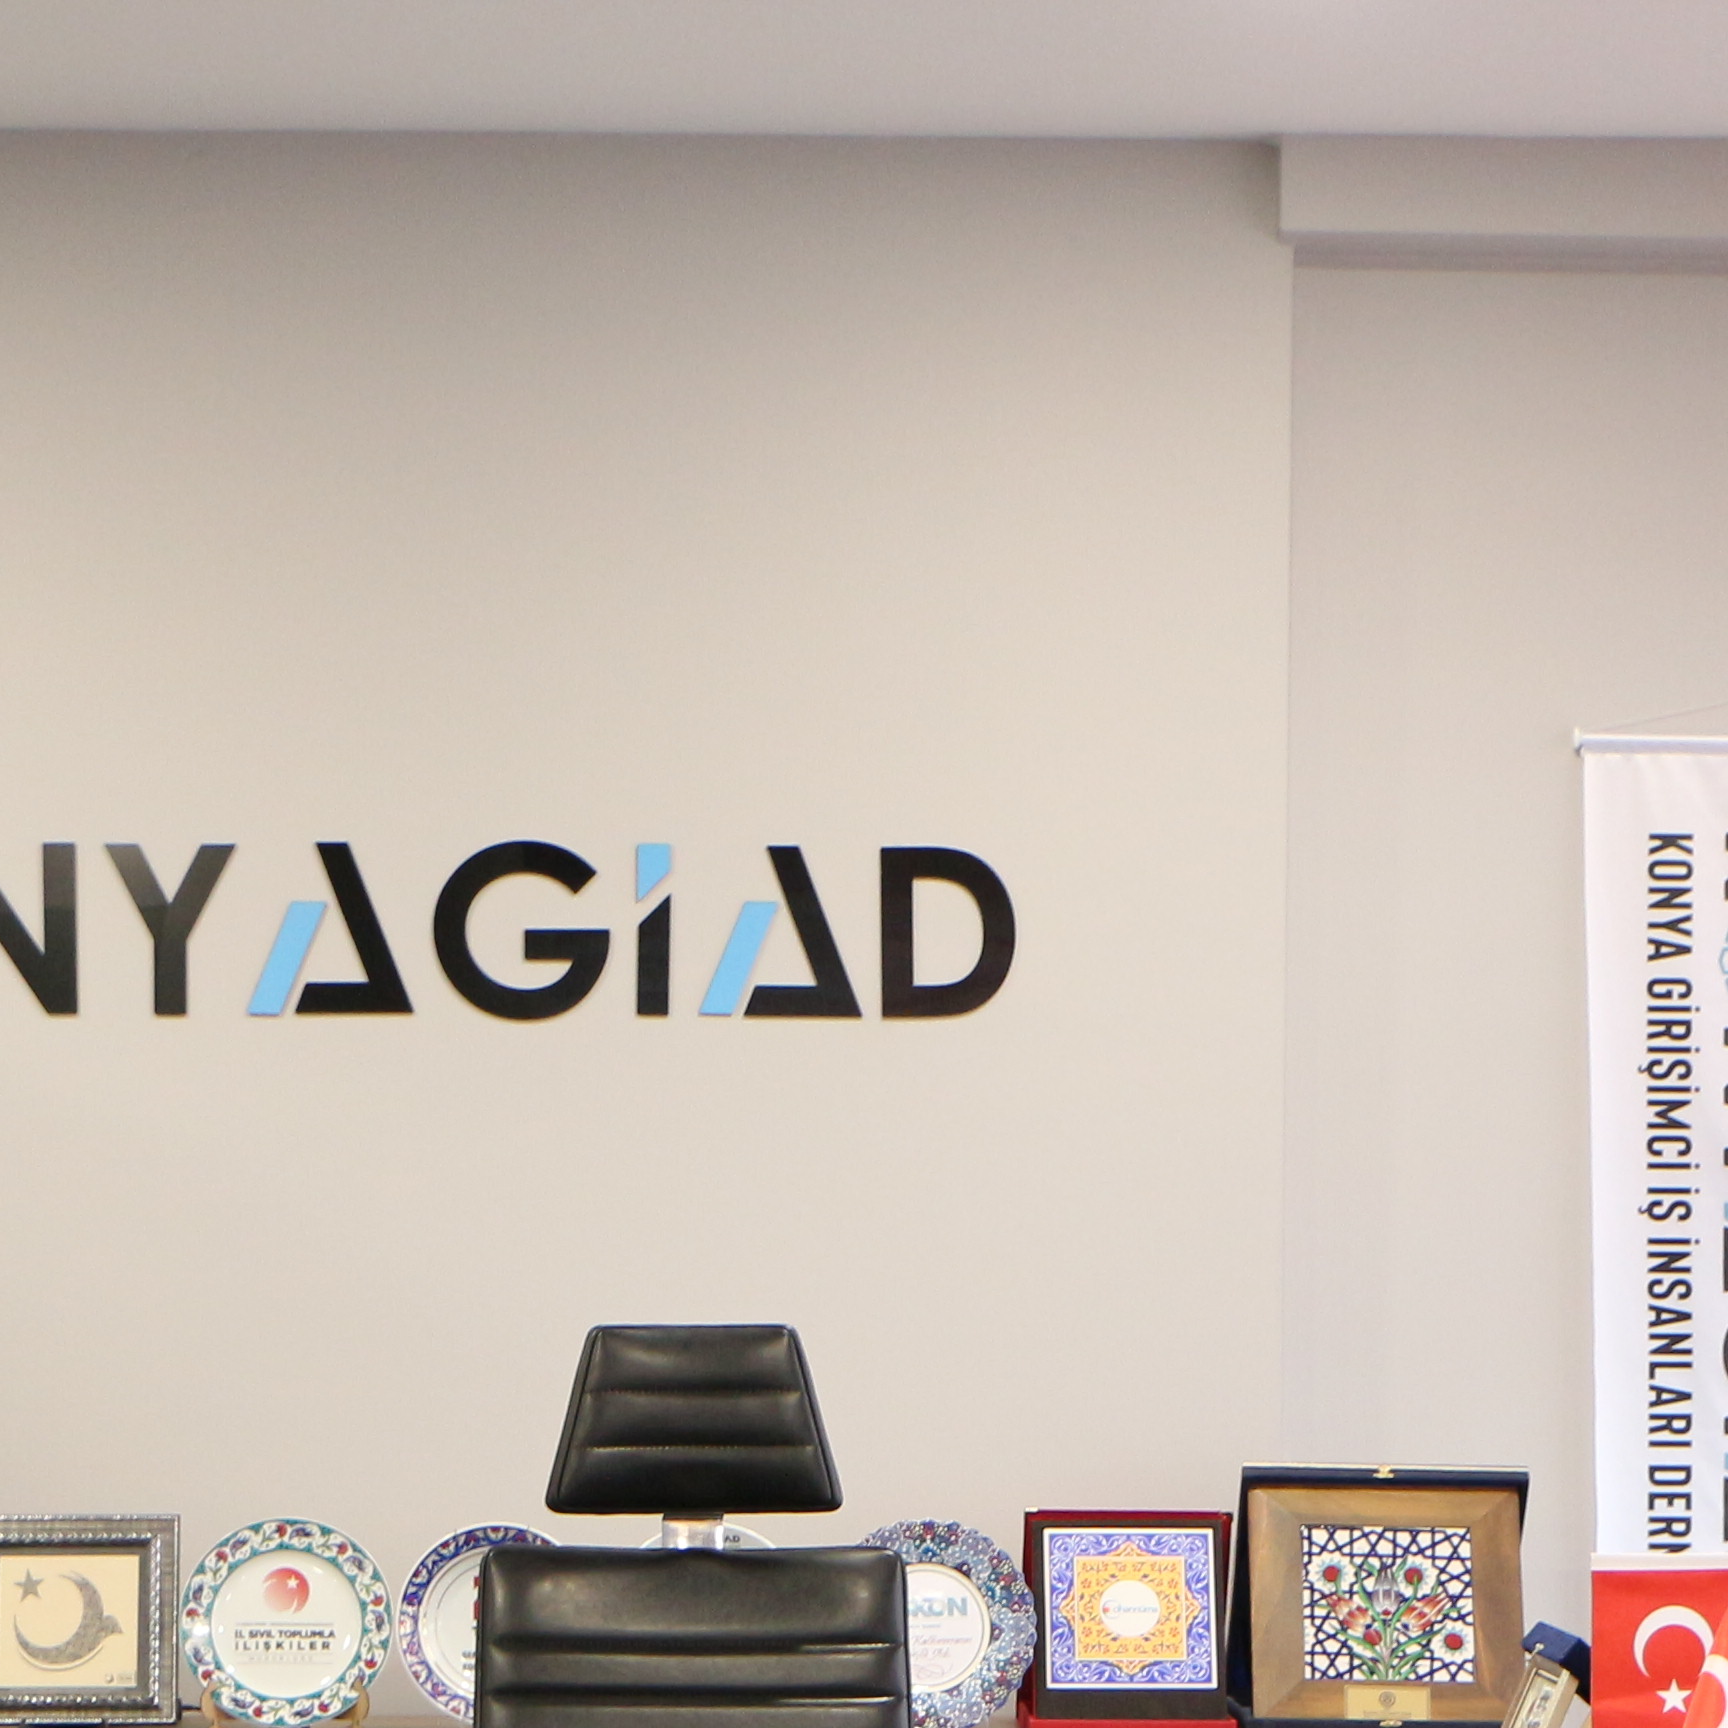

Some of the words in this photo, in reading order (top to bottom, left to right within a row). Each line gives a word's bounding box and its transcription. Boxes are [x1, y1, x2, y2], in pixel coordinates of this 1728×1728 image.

[1647, 832, 1695, 963] KONYA
[1637, 977, 1701, 1171] GİRİŞİMCİ
[1645, 1237, 1701, 1448] İNSANLARI
